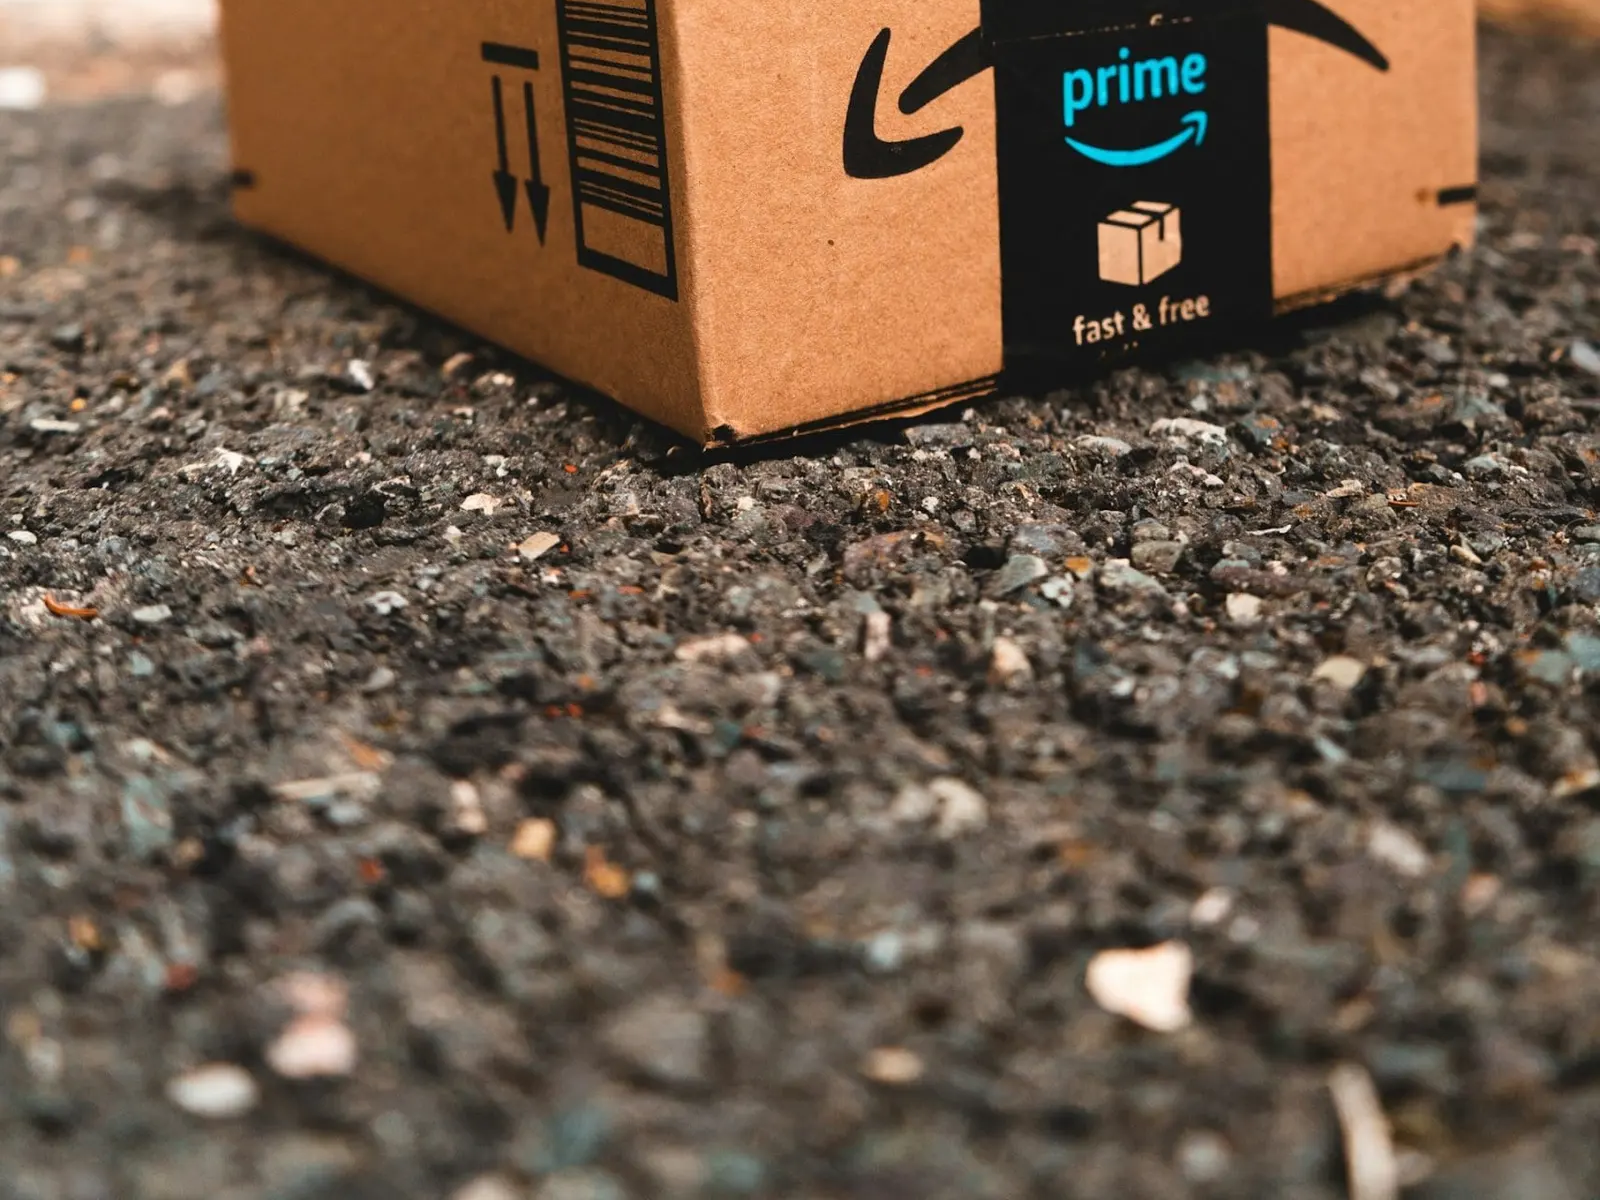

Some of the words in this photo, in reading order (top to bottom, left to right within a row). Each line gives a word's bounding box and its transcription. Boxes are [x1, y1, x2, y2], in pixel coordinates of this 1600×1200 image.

[1063, 46, 1207, 127] prime
[1072, 311, 1125, 346] fast
[1132, 303, 1152, 331] &
[1158, 294, 1211, 325] free
